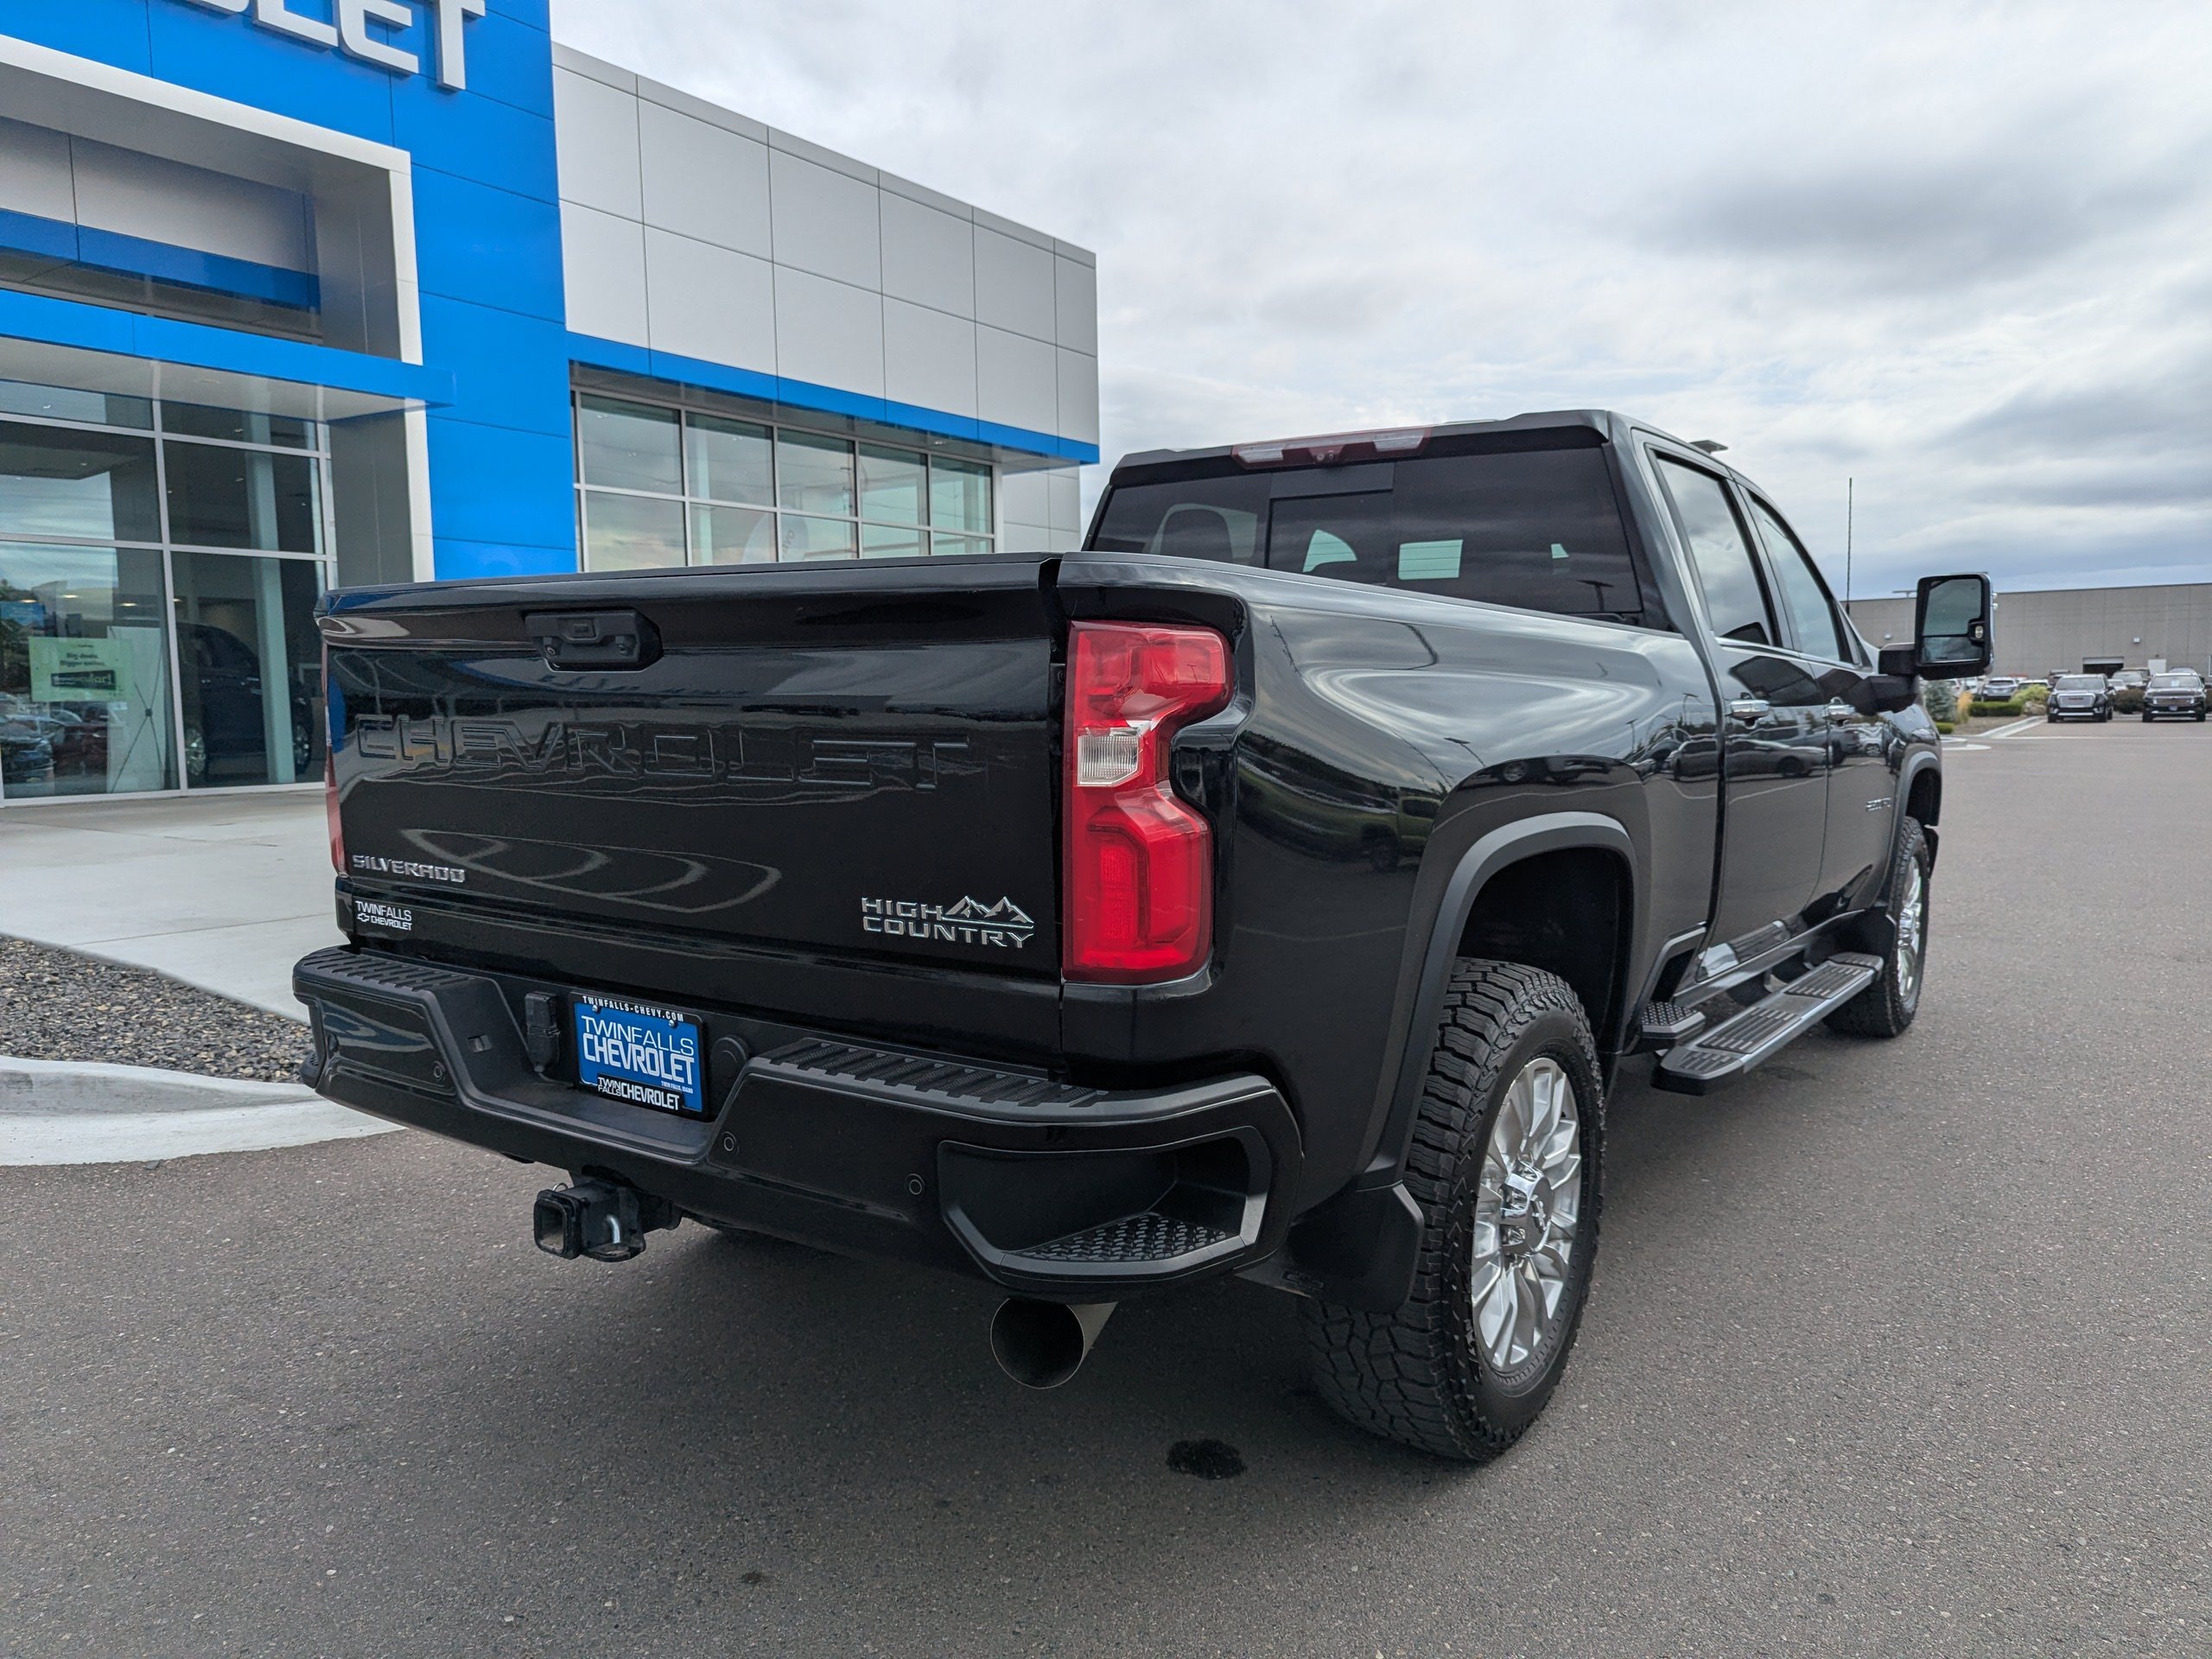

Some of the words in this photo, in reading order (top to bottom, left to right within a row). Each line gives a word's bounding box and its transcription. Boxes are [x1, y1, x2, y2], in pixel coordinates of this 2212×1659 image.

[183, 0, 486, 91] LET
[355, 712, 971, 793] CHEVROLET
[352, 855, 467, 883] SILVERADO
[355, 900, 412, 922] TWINFALLS
[861, 896, 944, 920] HIGH
[371, 915, 413, 931] CHEVROLET
[861, 916, 1034, 950] COUNTRY
[582, 995, 684, 1022] TWINFALLS-CHEVY.COM
[581, 1015, 695, 1057] TWINFALLS
[582, 1033, 695, 1085] CHEVROLET
[597, 1077, 621, 1090] TWIN
[597, 1084, 621, 1097] FALLS
[621, 1082, 680, 1111] CHEVROLET
